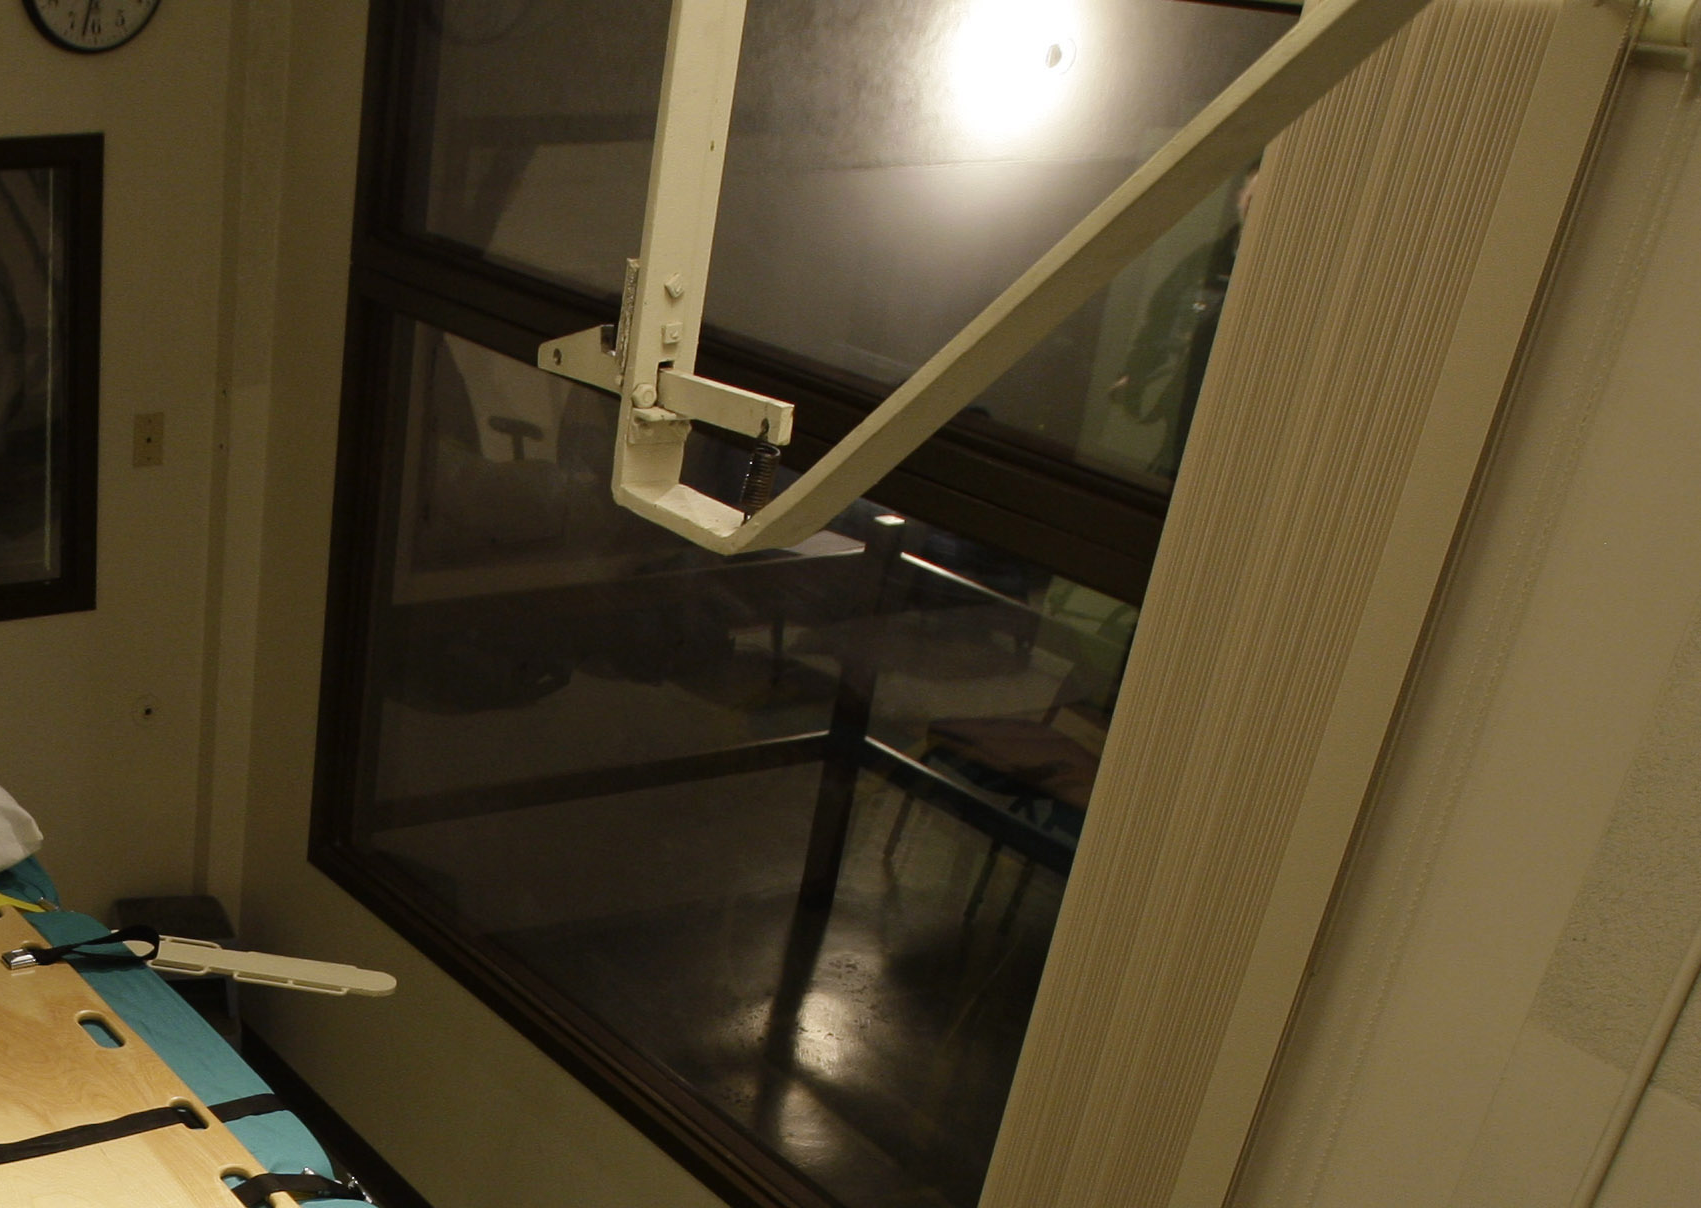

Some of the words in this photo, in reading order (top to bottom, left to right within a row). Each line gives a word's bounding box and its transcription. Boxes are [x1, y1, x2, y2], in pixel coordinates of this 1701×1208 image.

[68, 11, 76, 30] 7
[91, 18, 102, 34] 6
[115, 9, 126, 26] 5
